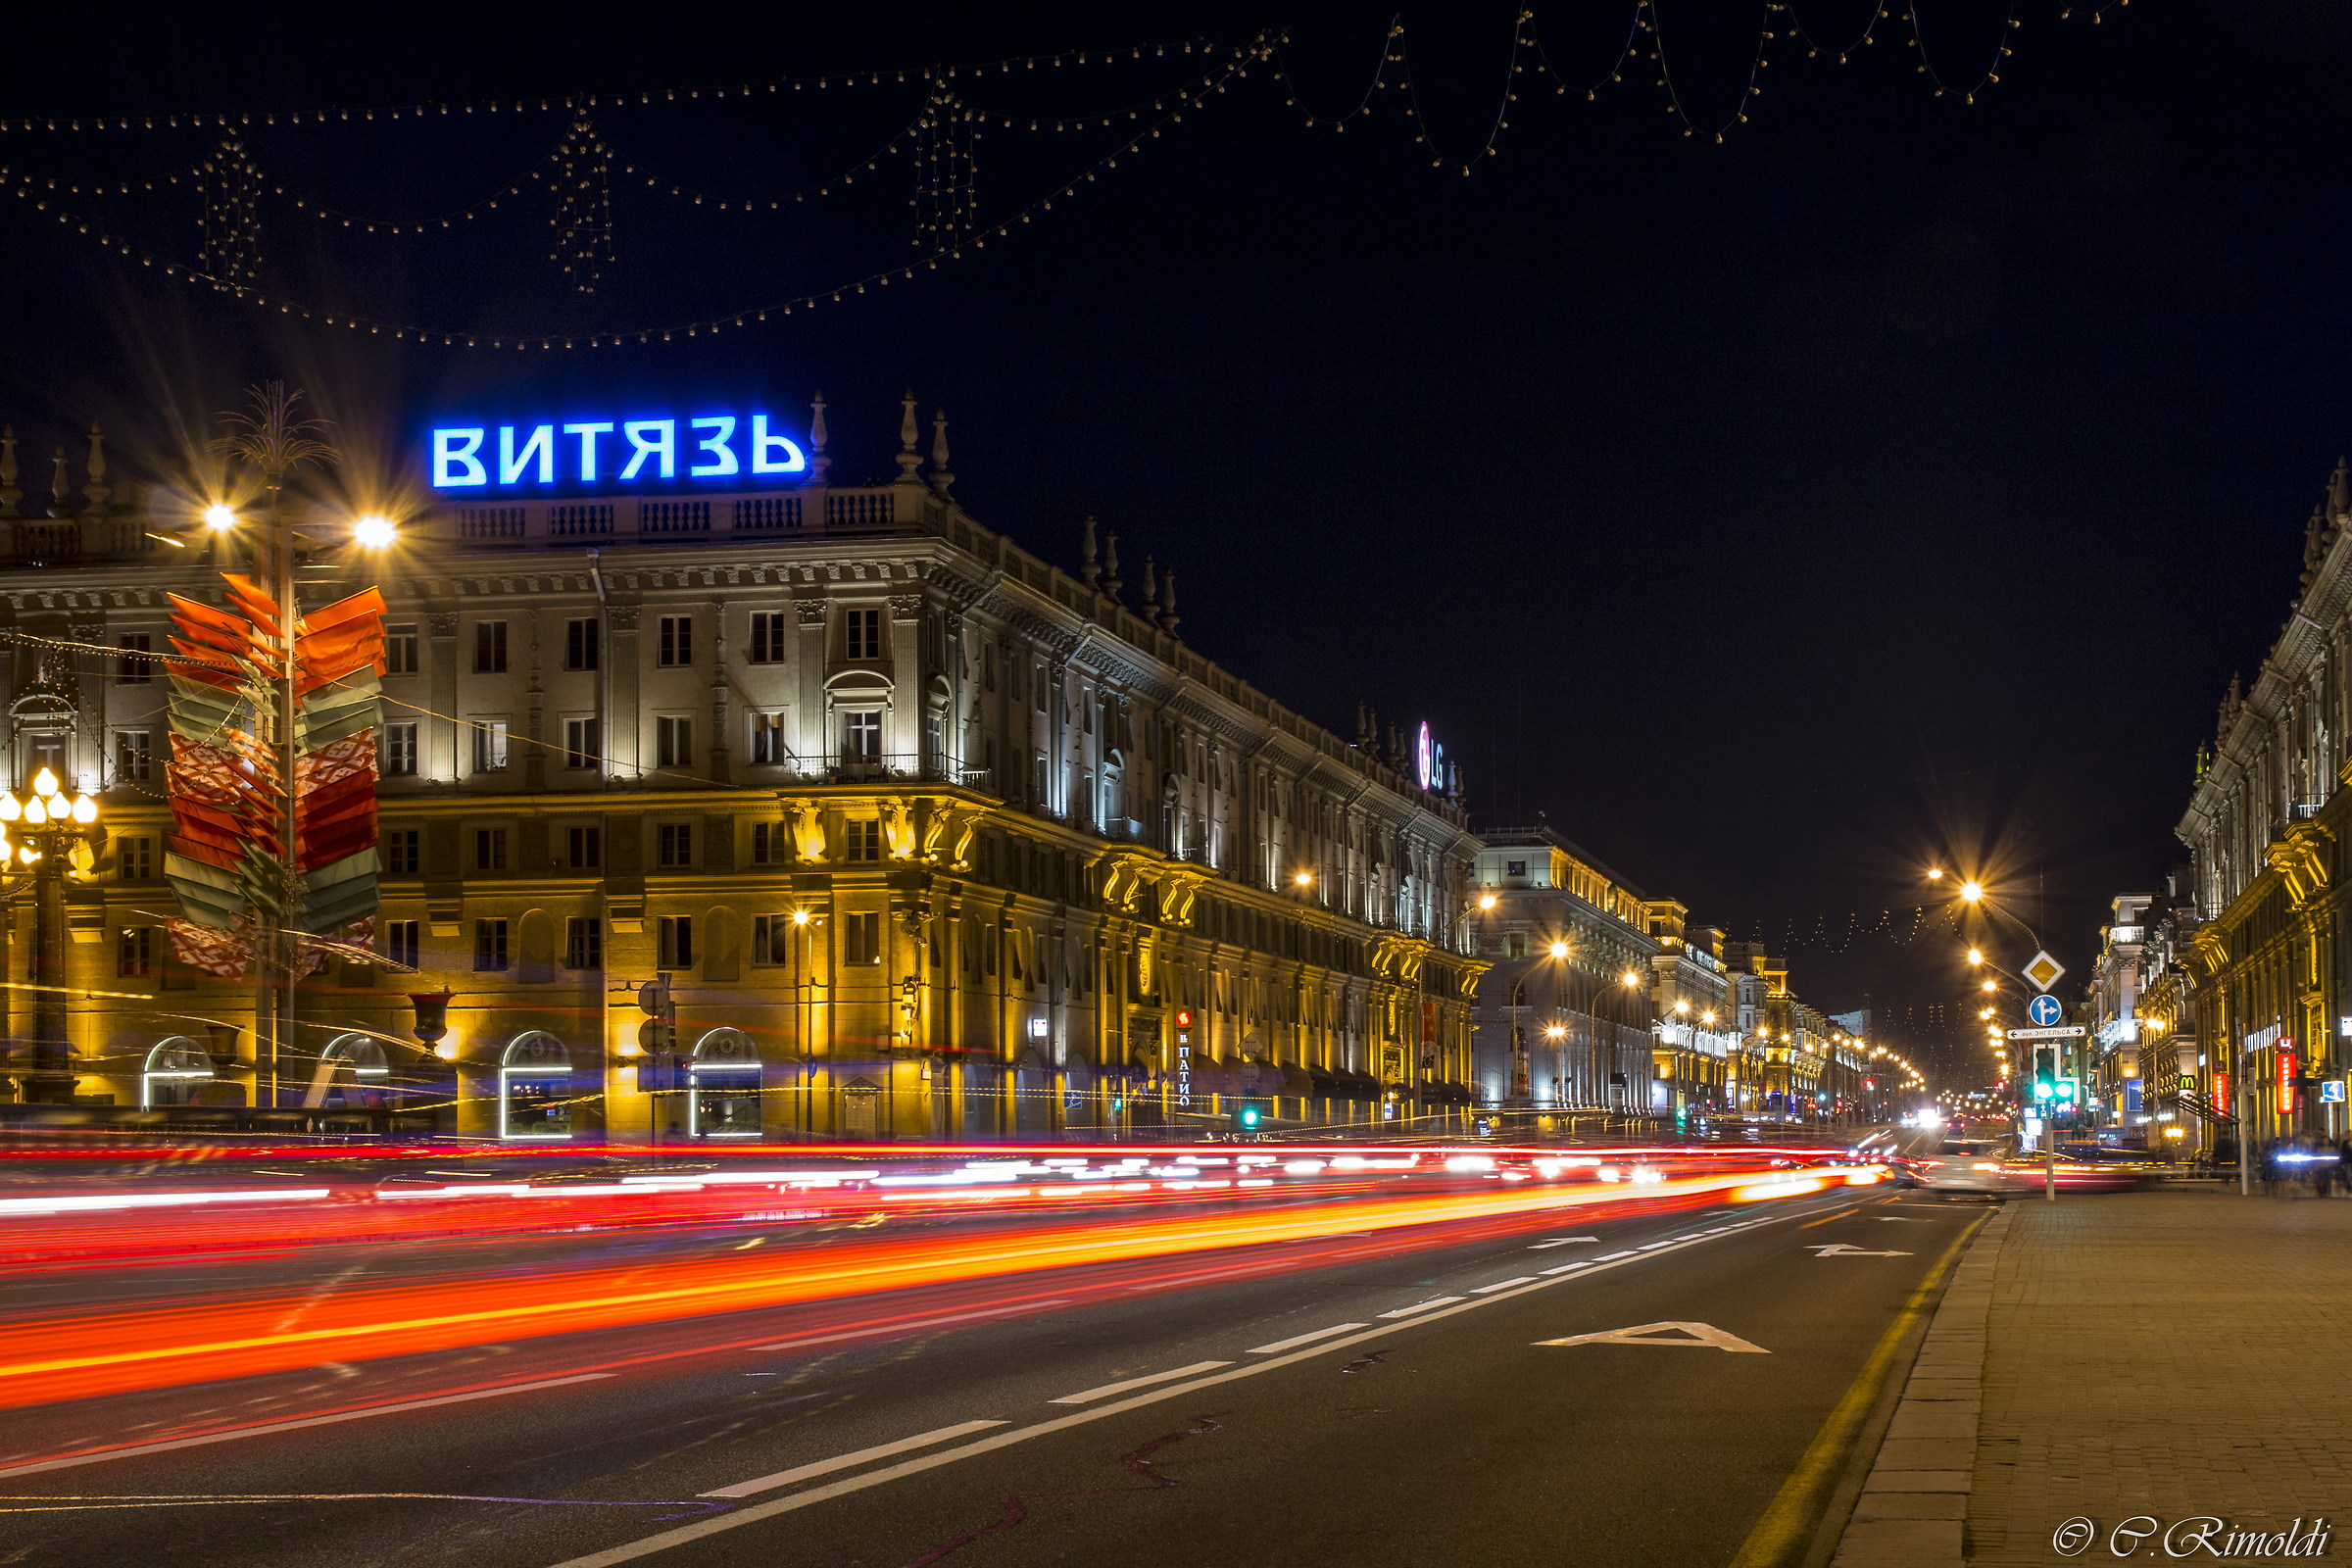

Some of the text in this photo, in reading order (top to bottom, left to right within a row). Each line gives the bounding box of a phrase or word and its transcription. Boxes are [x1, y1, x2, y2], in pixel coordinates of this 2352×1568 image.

[433, 415, 806, 487] ВИТЯЗЬ
[1431, 738, 1443, 790] LG
[1178, 1047, 1190, 1106] ПАТИО
